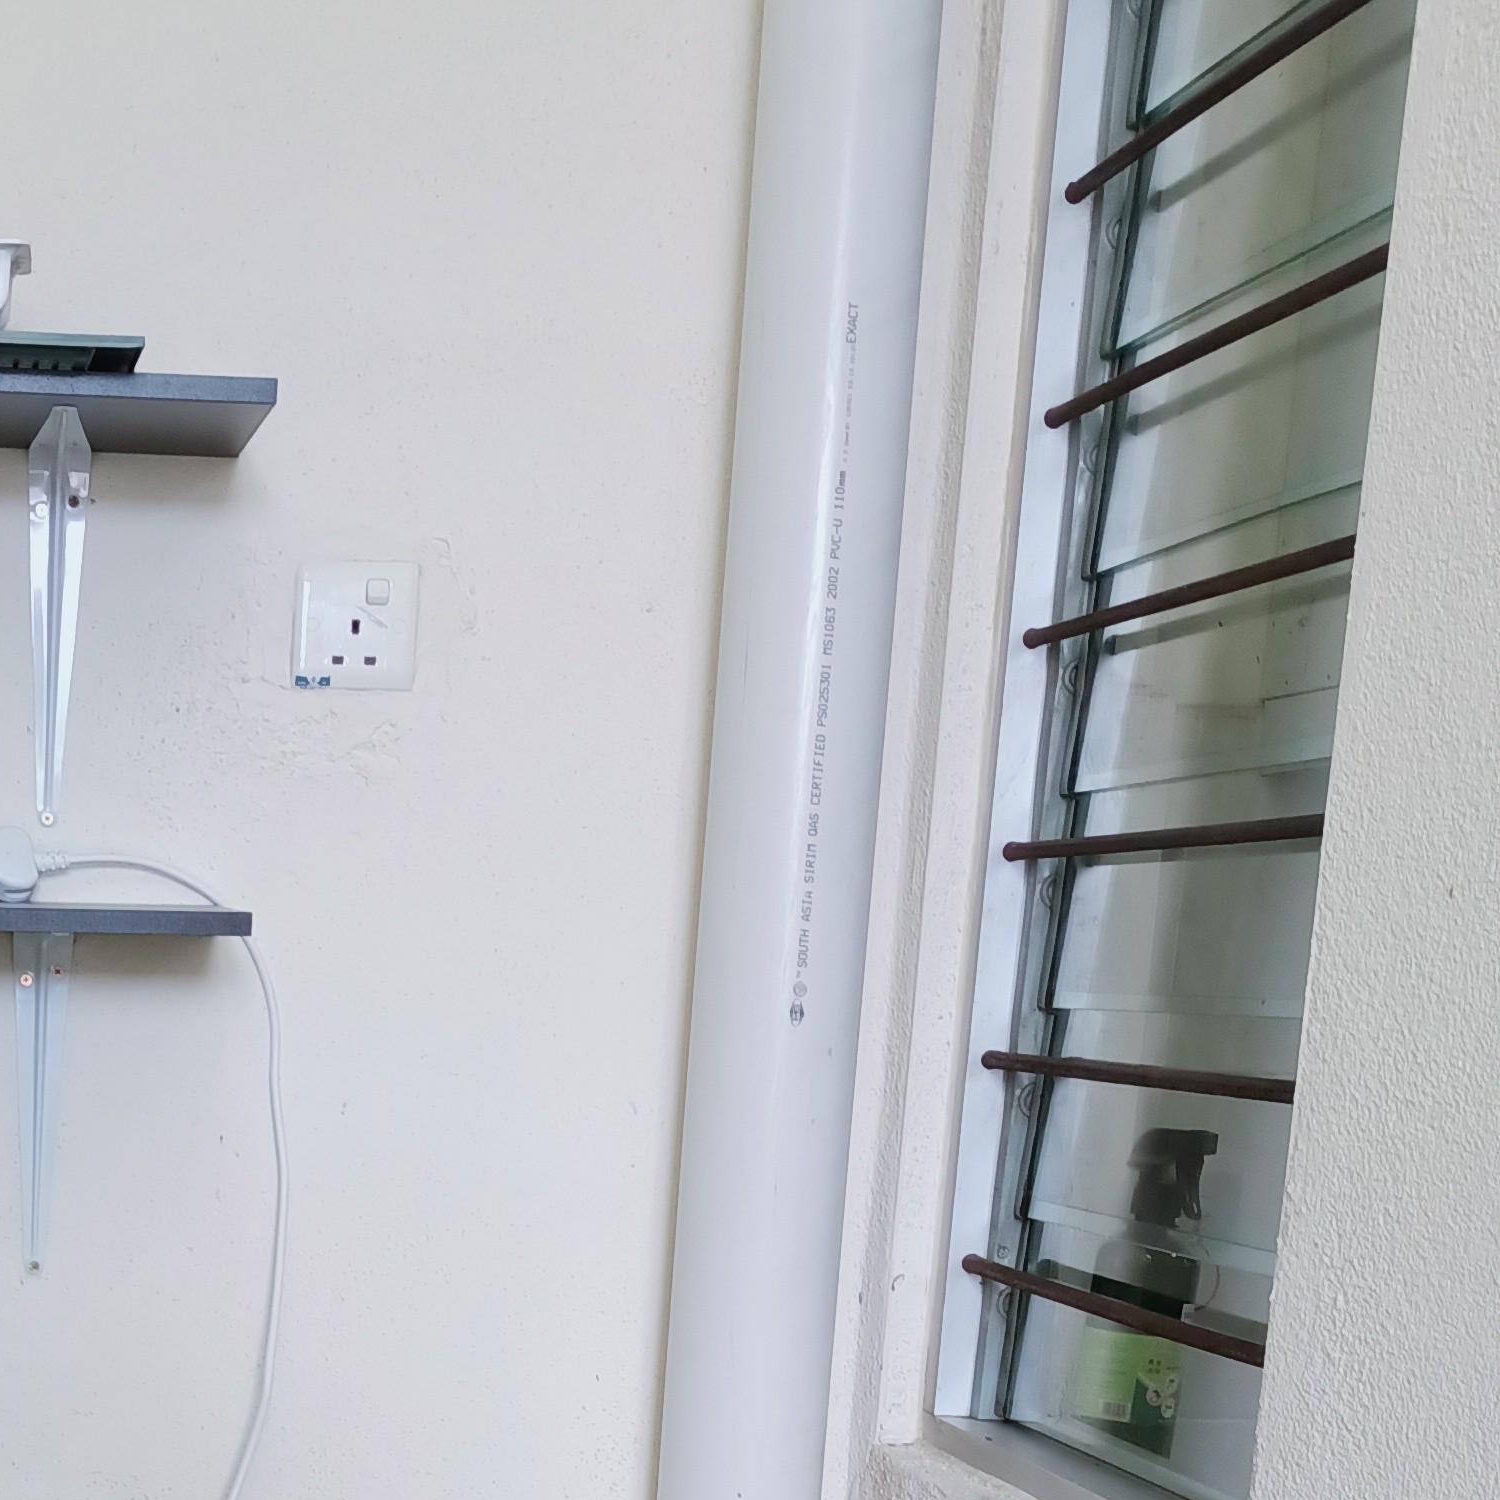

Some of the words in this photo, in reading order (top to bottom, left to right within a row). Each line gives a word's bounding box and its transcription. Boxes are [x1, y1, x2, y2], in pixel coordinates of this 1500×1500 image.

[846, 303, 860, 344] EXACT
[834, 470, 846, 510] 110mm
[830, 518, 843, 561] PVC-U
[827, 566, 839, 600] 2002
[823, 607, 836, 656] MS1063
[817, 664, 831, 727] PS025301
[811, 733, 826, 806] CERTIFIED
[804, 843, 817, 884] SIRIM
[801, 890, 813, 922] ASIA
[797, 929, 809, 968] SOUTH
